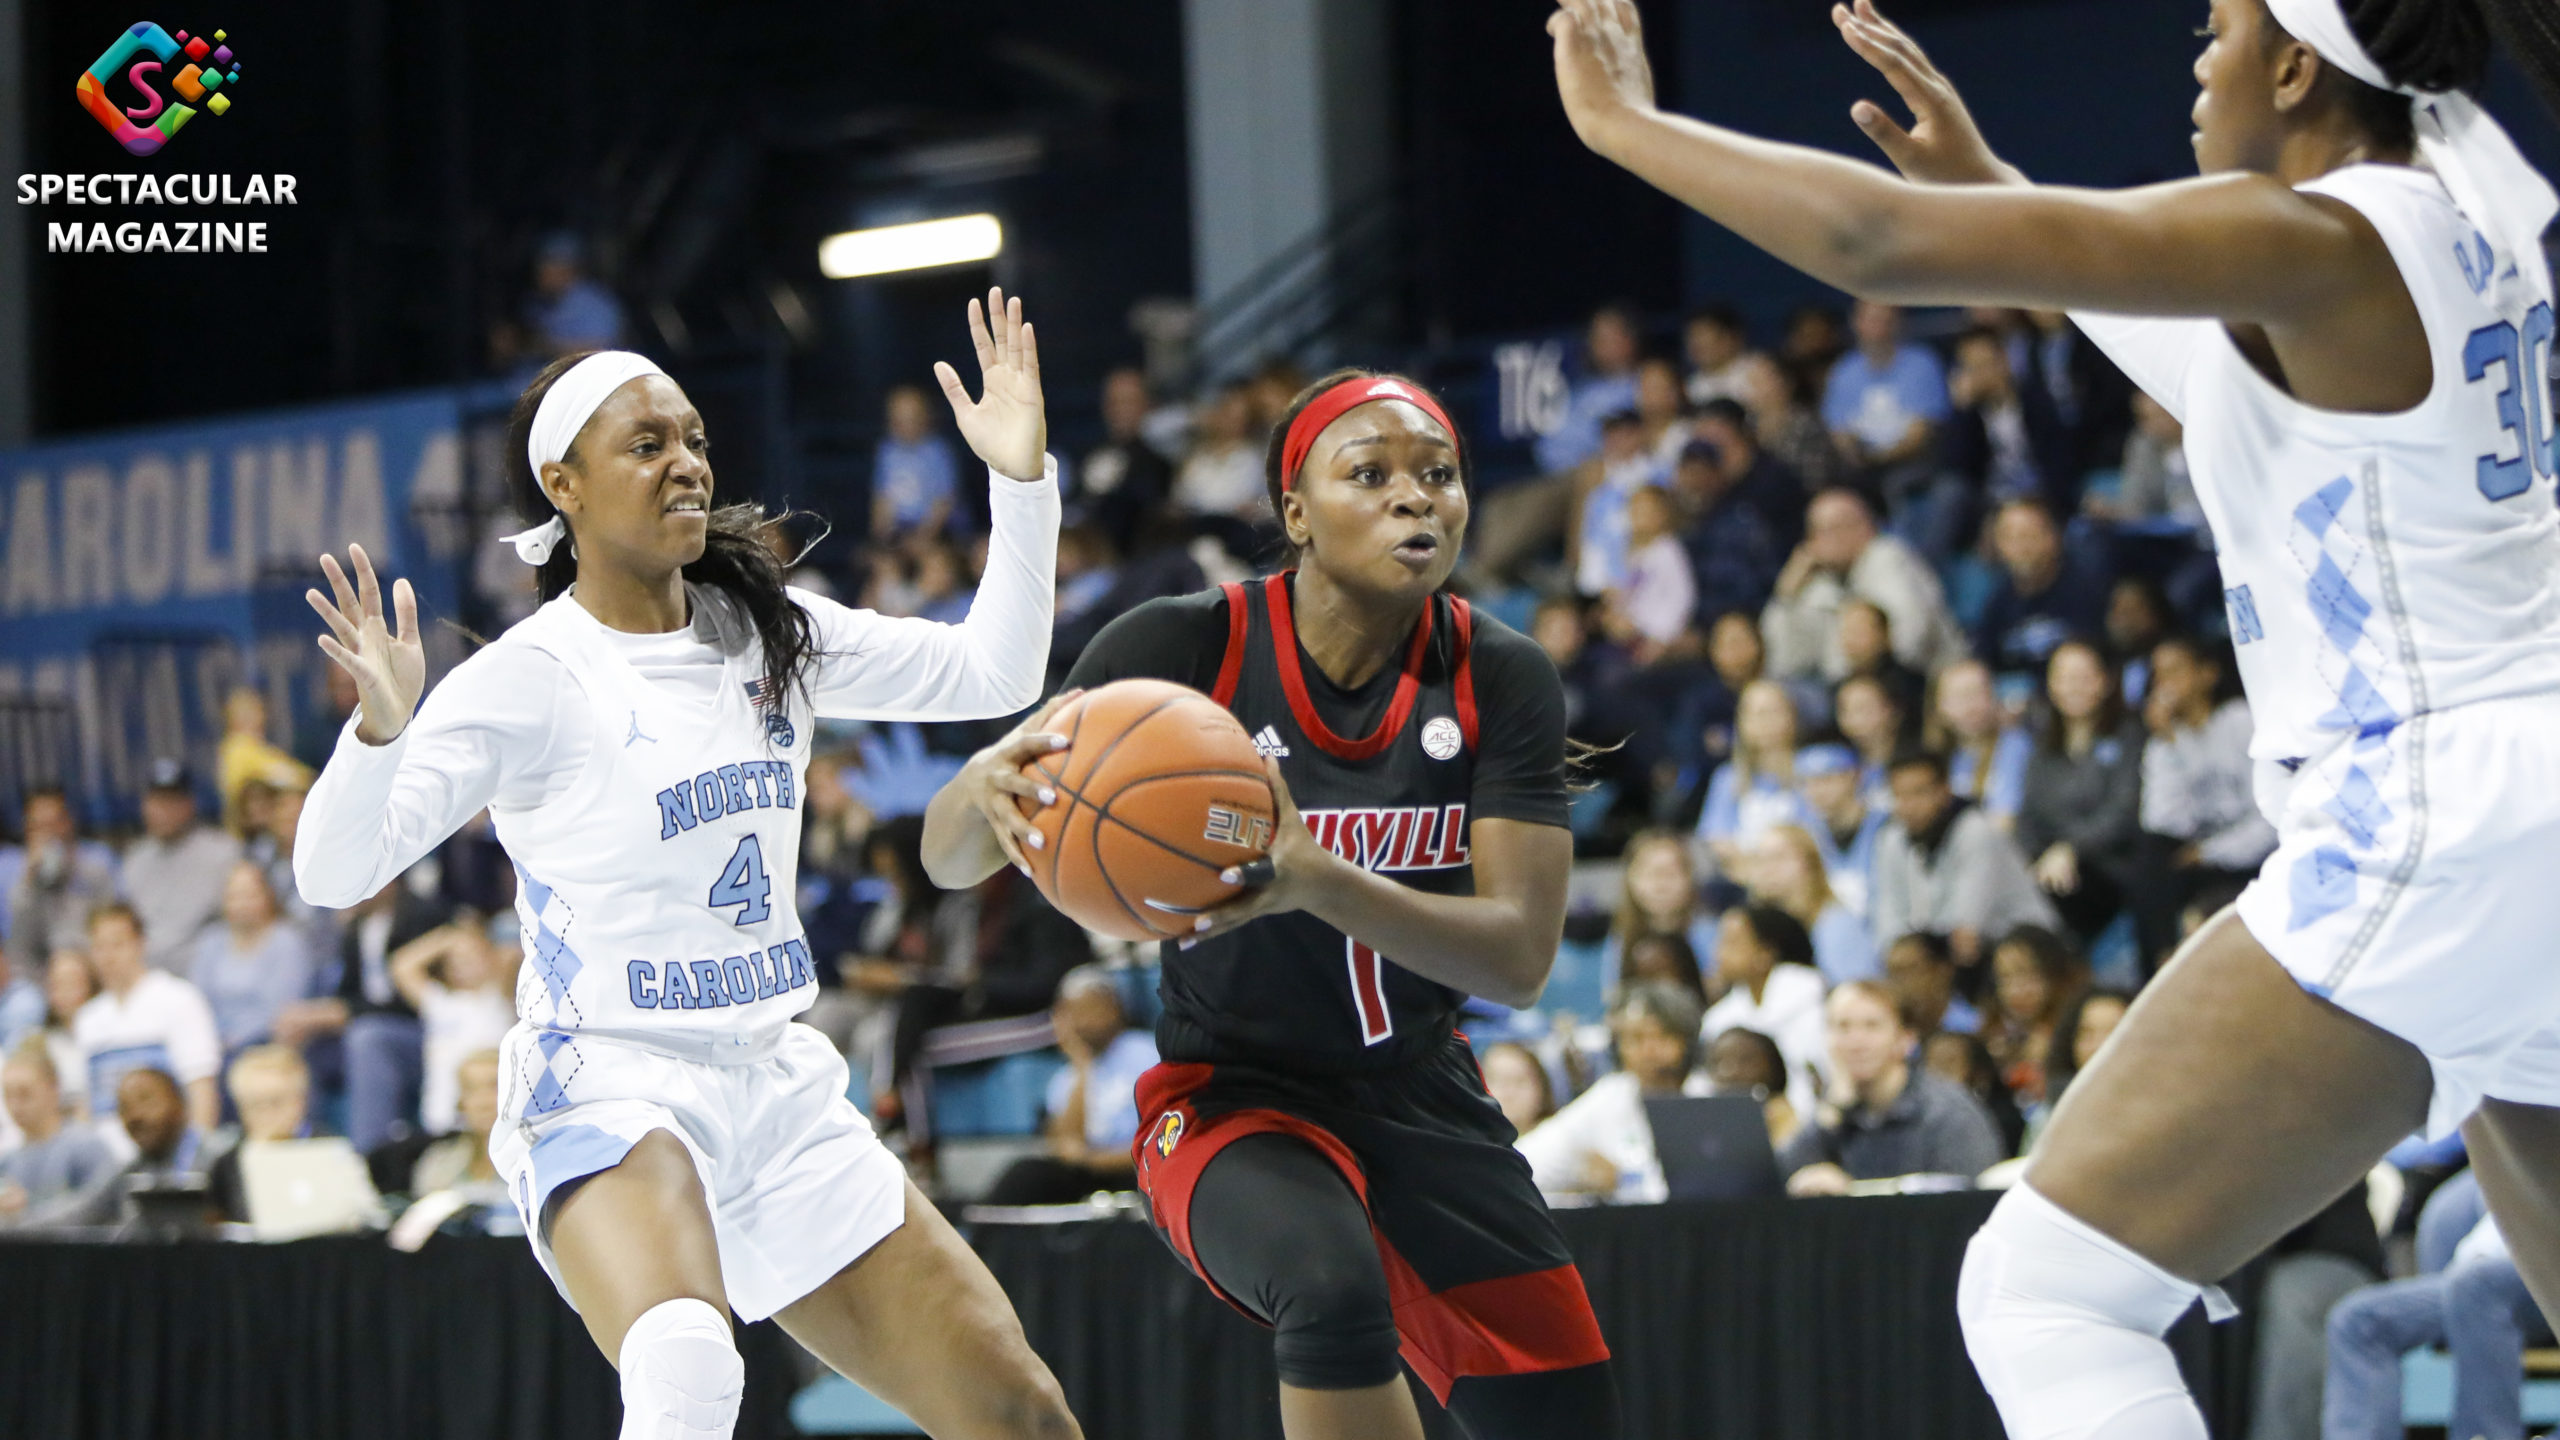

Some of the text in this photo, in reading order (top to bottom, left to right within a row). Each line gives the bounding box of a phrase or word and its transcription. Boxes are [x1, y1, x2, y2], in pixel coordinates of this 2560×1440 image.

[2462, 299, 2554, 503] 30
[1, 430, 391, 617] AROLINA
[1428, 730, 1457, 742] ACC
[656, 760, 795, 840] NORTH
[708, 832, 771, 926] 4
[627, 933, 817, 1010] CAROLIN
